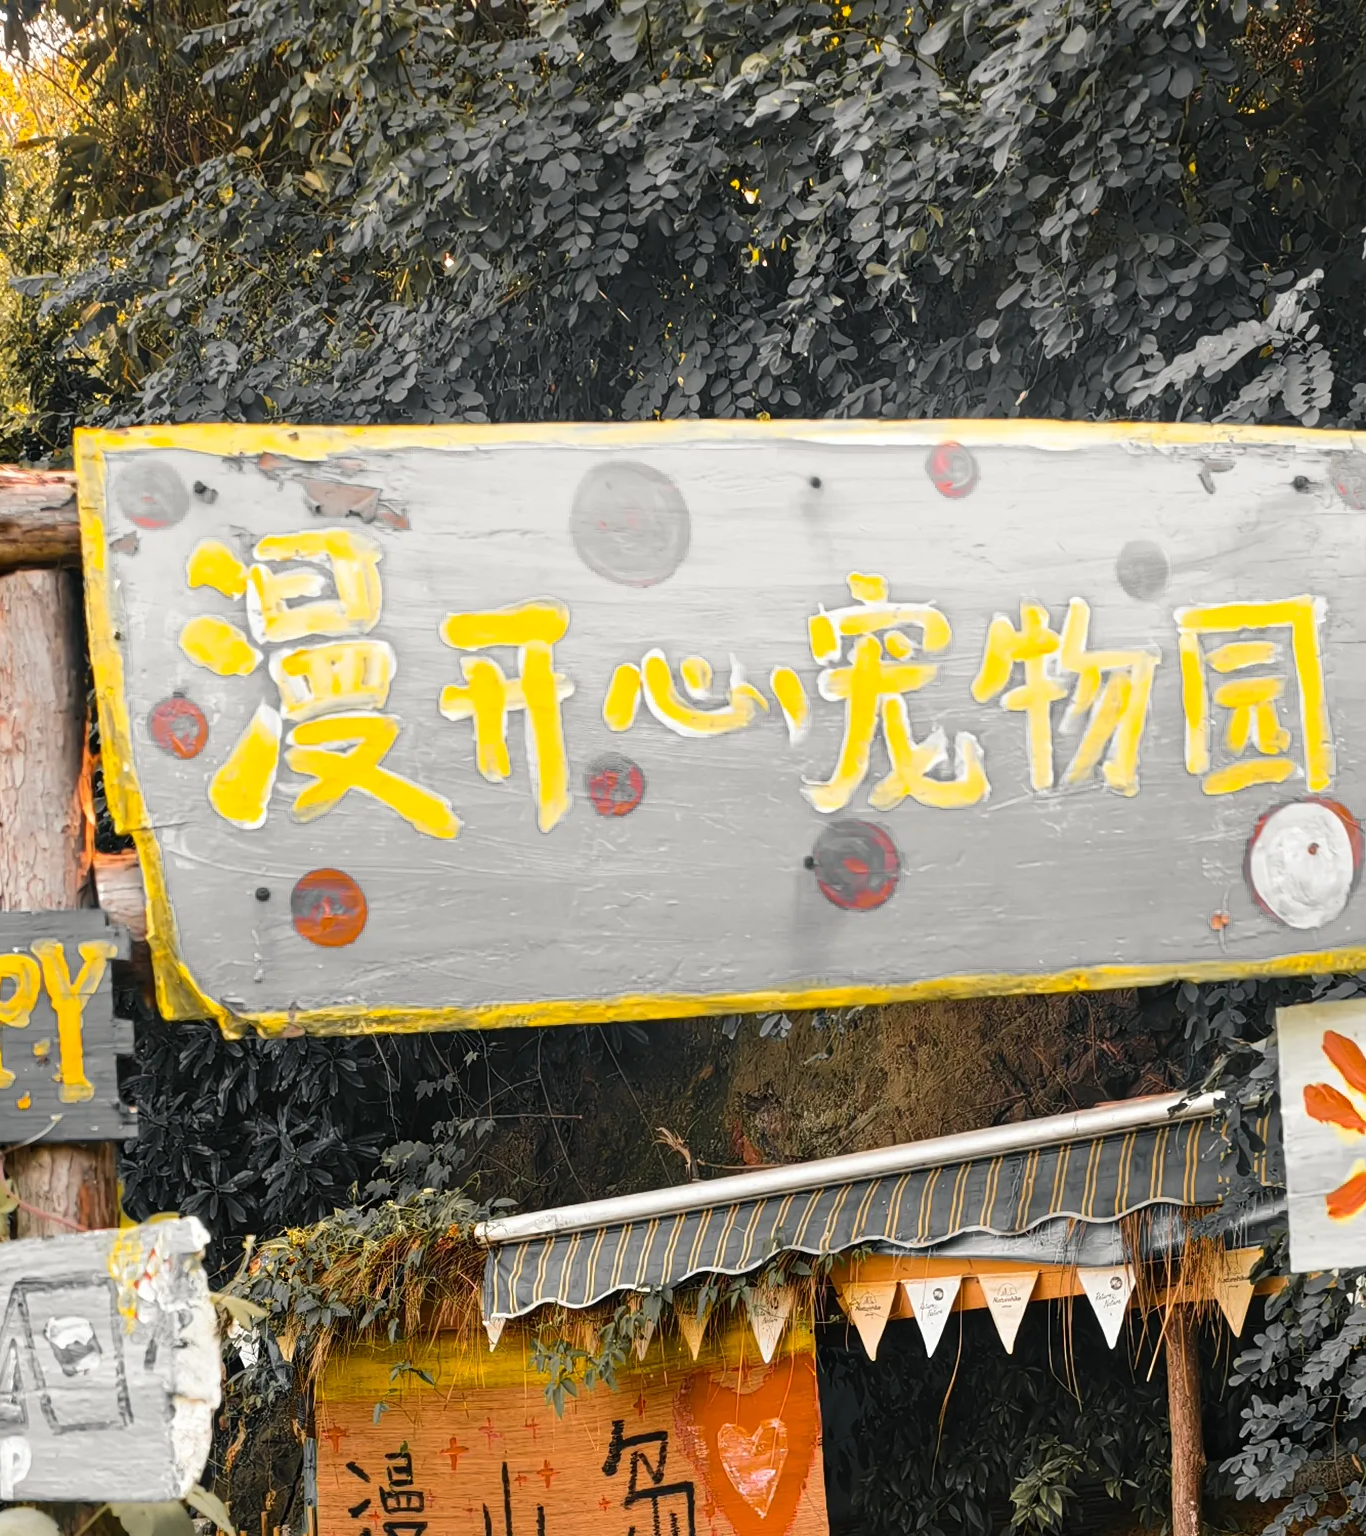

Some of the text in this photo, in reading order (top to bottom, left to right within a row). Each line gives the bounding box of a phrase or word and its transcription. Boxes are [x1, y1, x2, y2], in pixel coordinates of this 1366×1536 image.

[177, 524, 1331, 841] 漫开心宠物园
